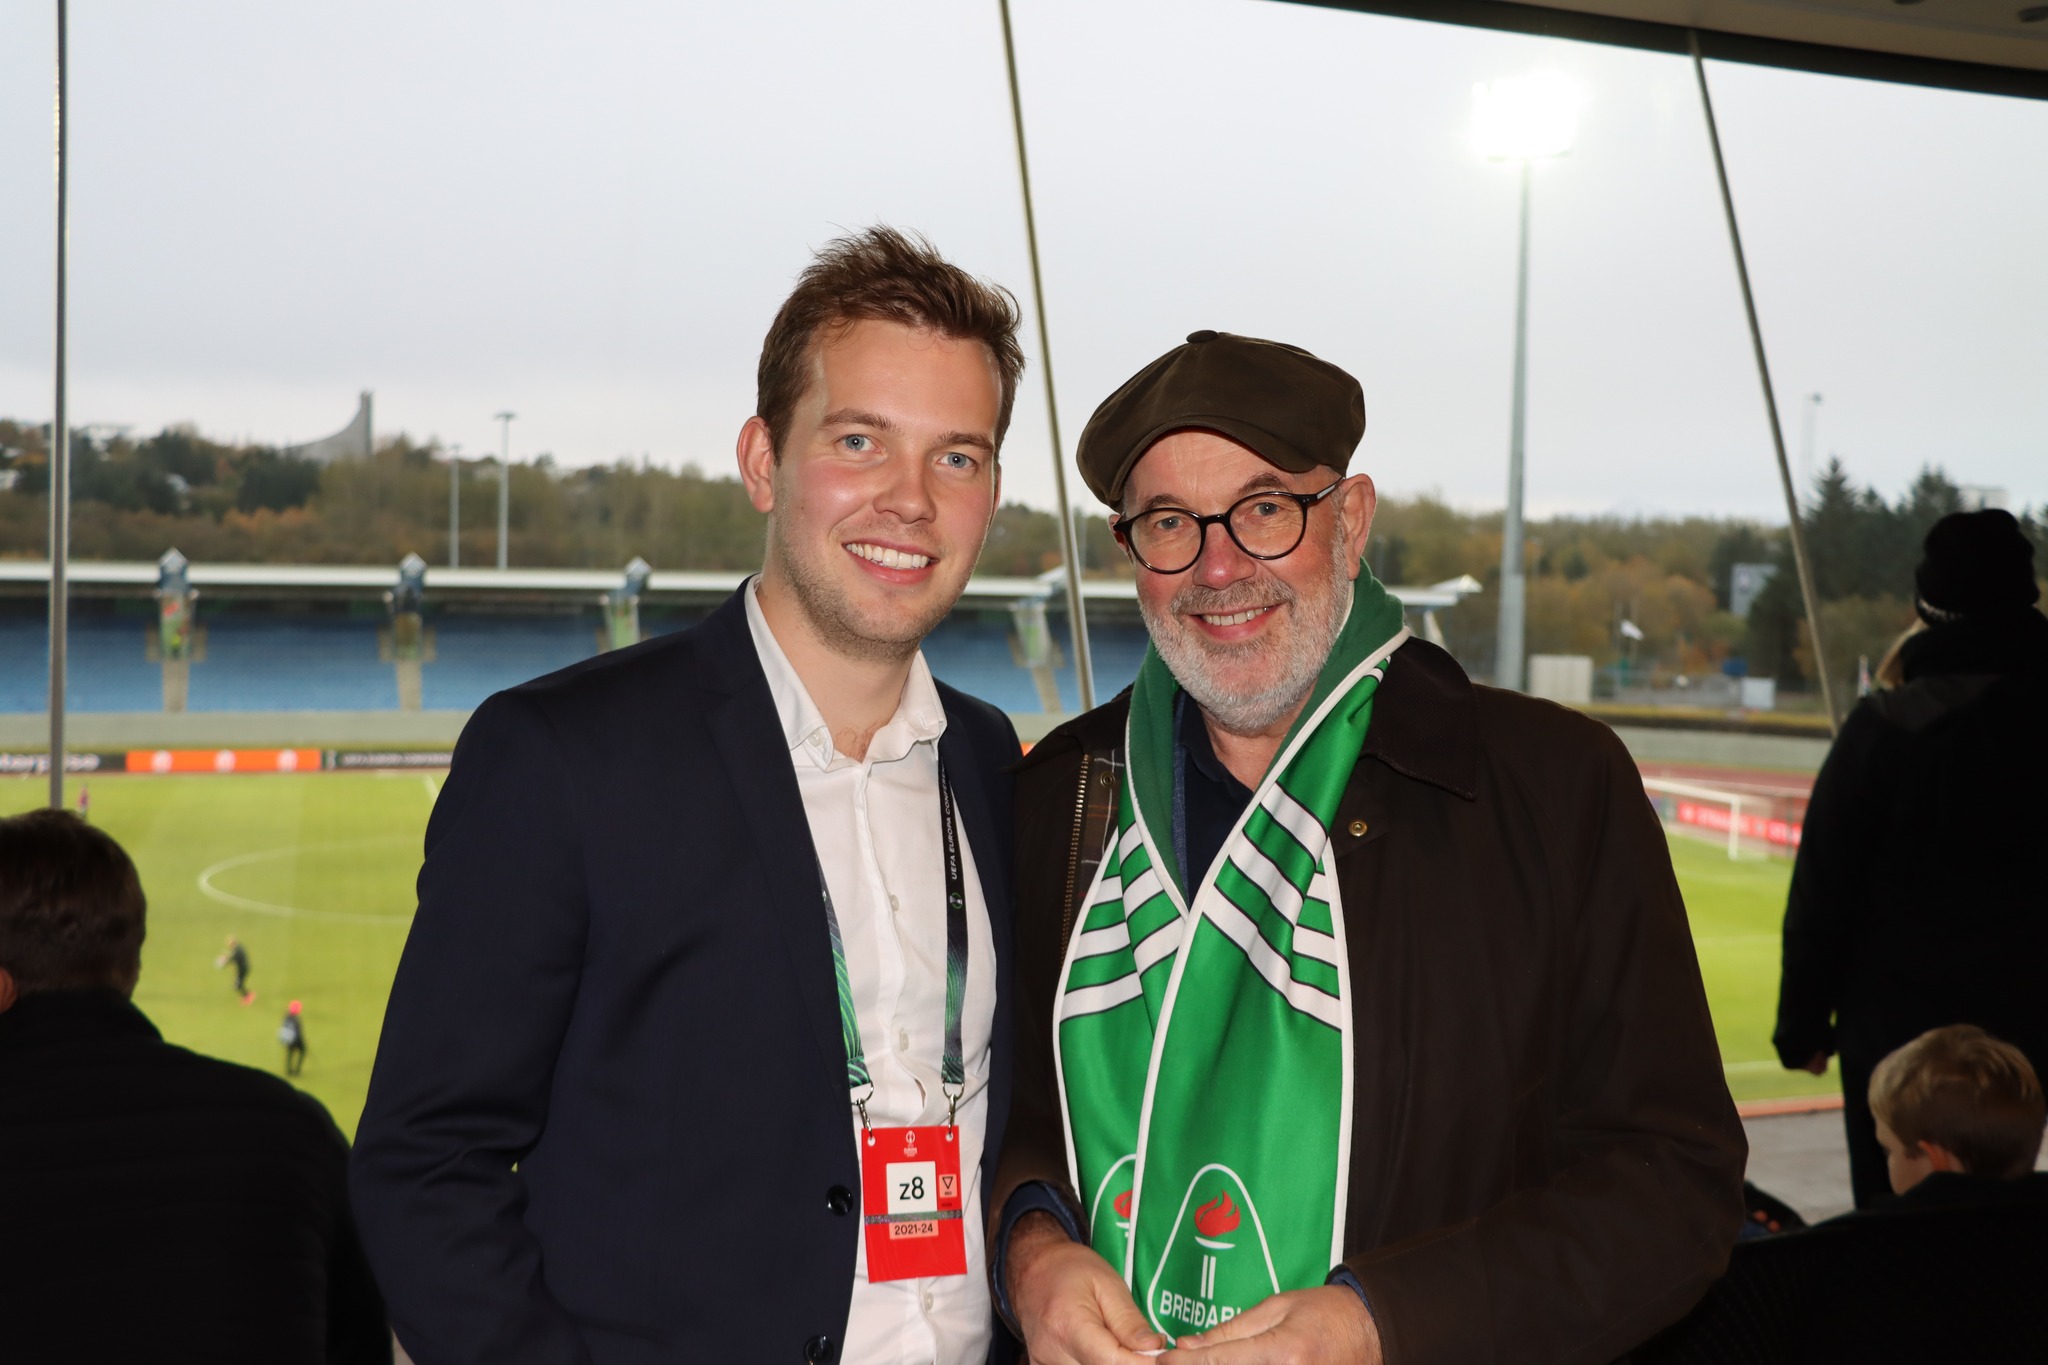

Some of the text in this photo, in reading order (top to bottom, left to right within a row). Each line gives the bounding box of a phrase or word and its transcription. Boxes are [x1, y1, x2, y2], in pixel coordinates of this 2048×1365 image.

[946, 817, 955, 853] EUROPA
[950, 855, 958, 880] UEFA
[894, 1223, 933, 1235] 2021-24
